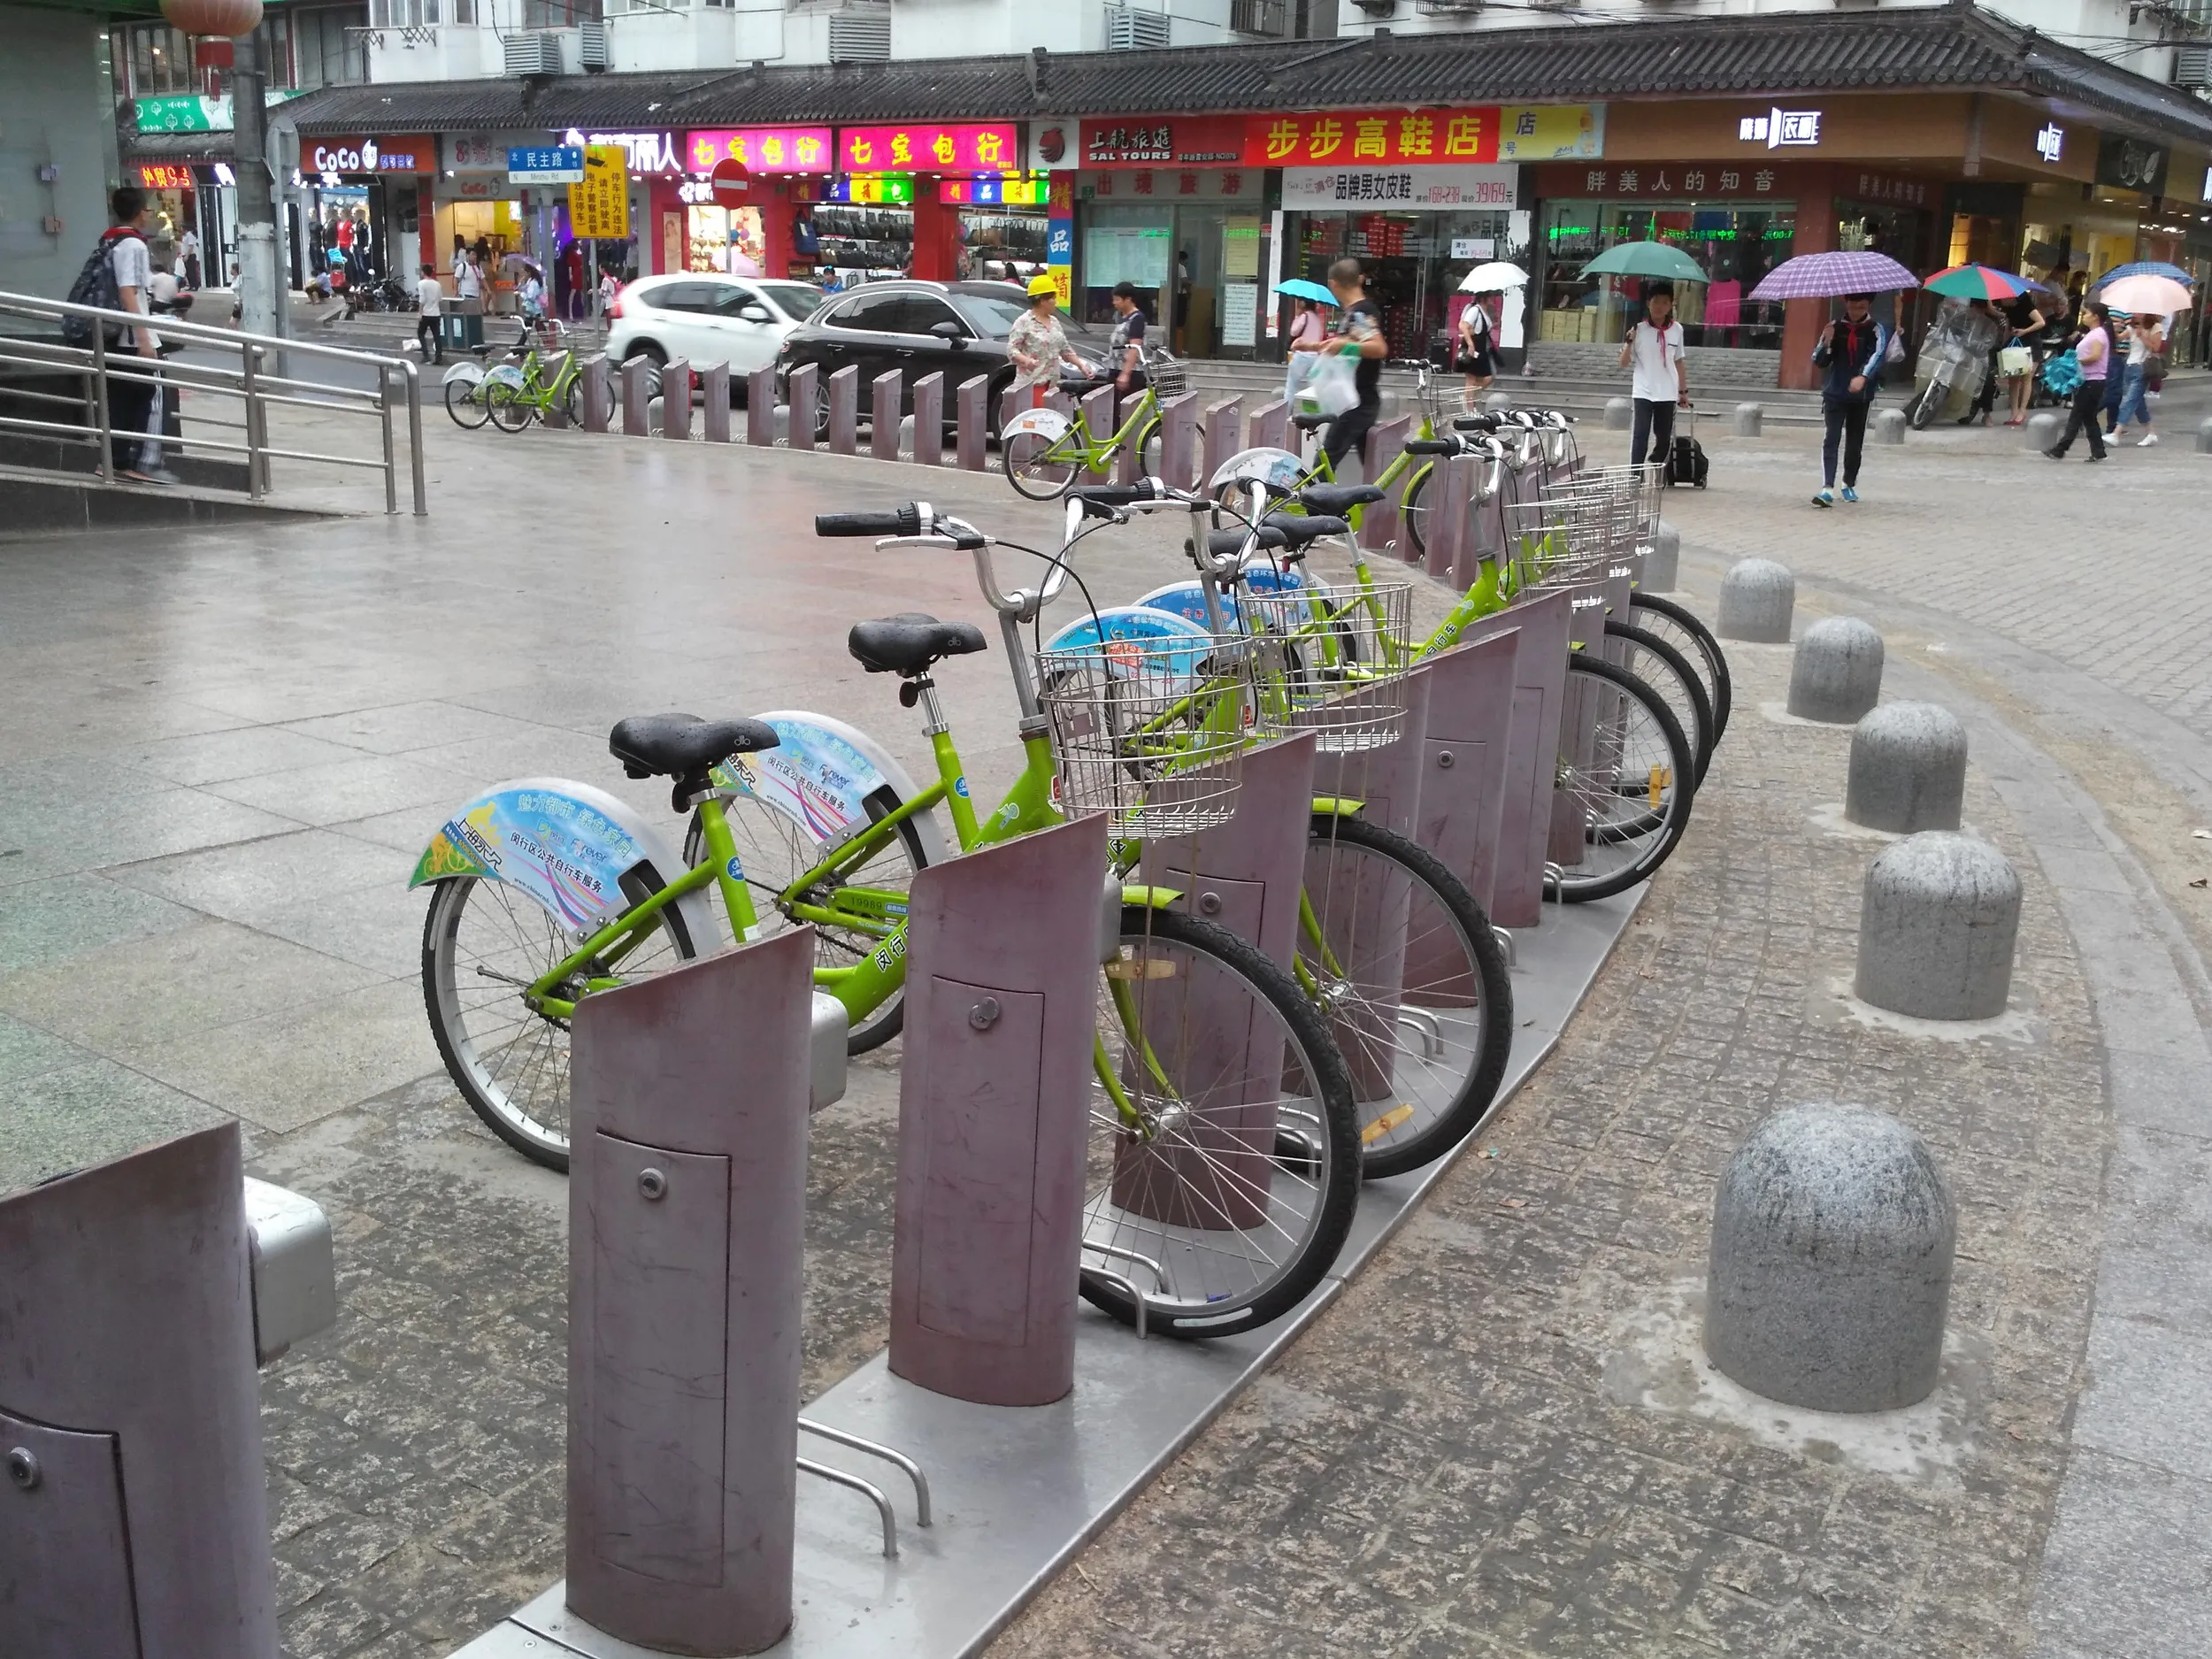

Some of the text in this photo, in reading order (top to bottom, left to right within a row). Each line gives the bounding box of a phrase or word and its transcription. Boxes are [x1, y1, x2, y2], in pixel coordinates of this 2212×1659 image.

[1267, 115, 1481, 159] 步步高鞋店
[1516, 111, 1537, 135] 店
[527, 151, 562, 168] 民主路
[694, 135, 821, 165] 七宝包行
[849, 133, 1002, 165] 七宝包行
[1089, 151, 1171, 161] SAL TOURS
[1335, 173, 1411, 200] 品牌男女皮鞋
[1586, 169, 1774, 191] 胖美人的知音
[766, 756, 847, 812] 闵行区公共自行车服务
[510, 830, 603, 895] 闵行区公共自行车服务
